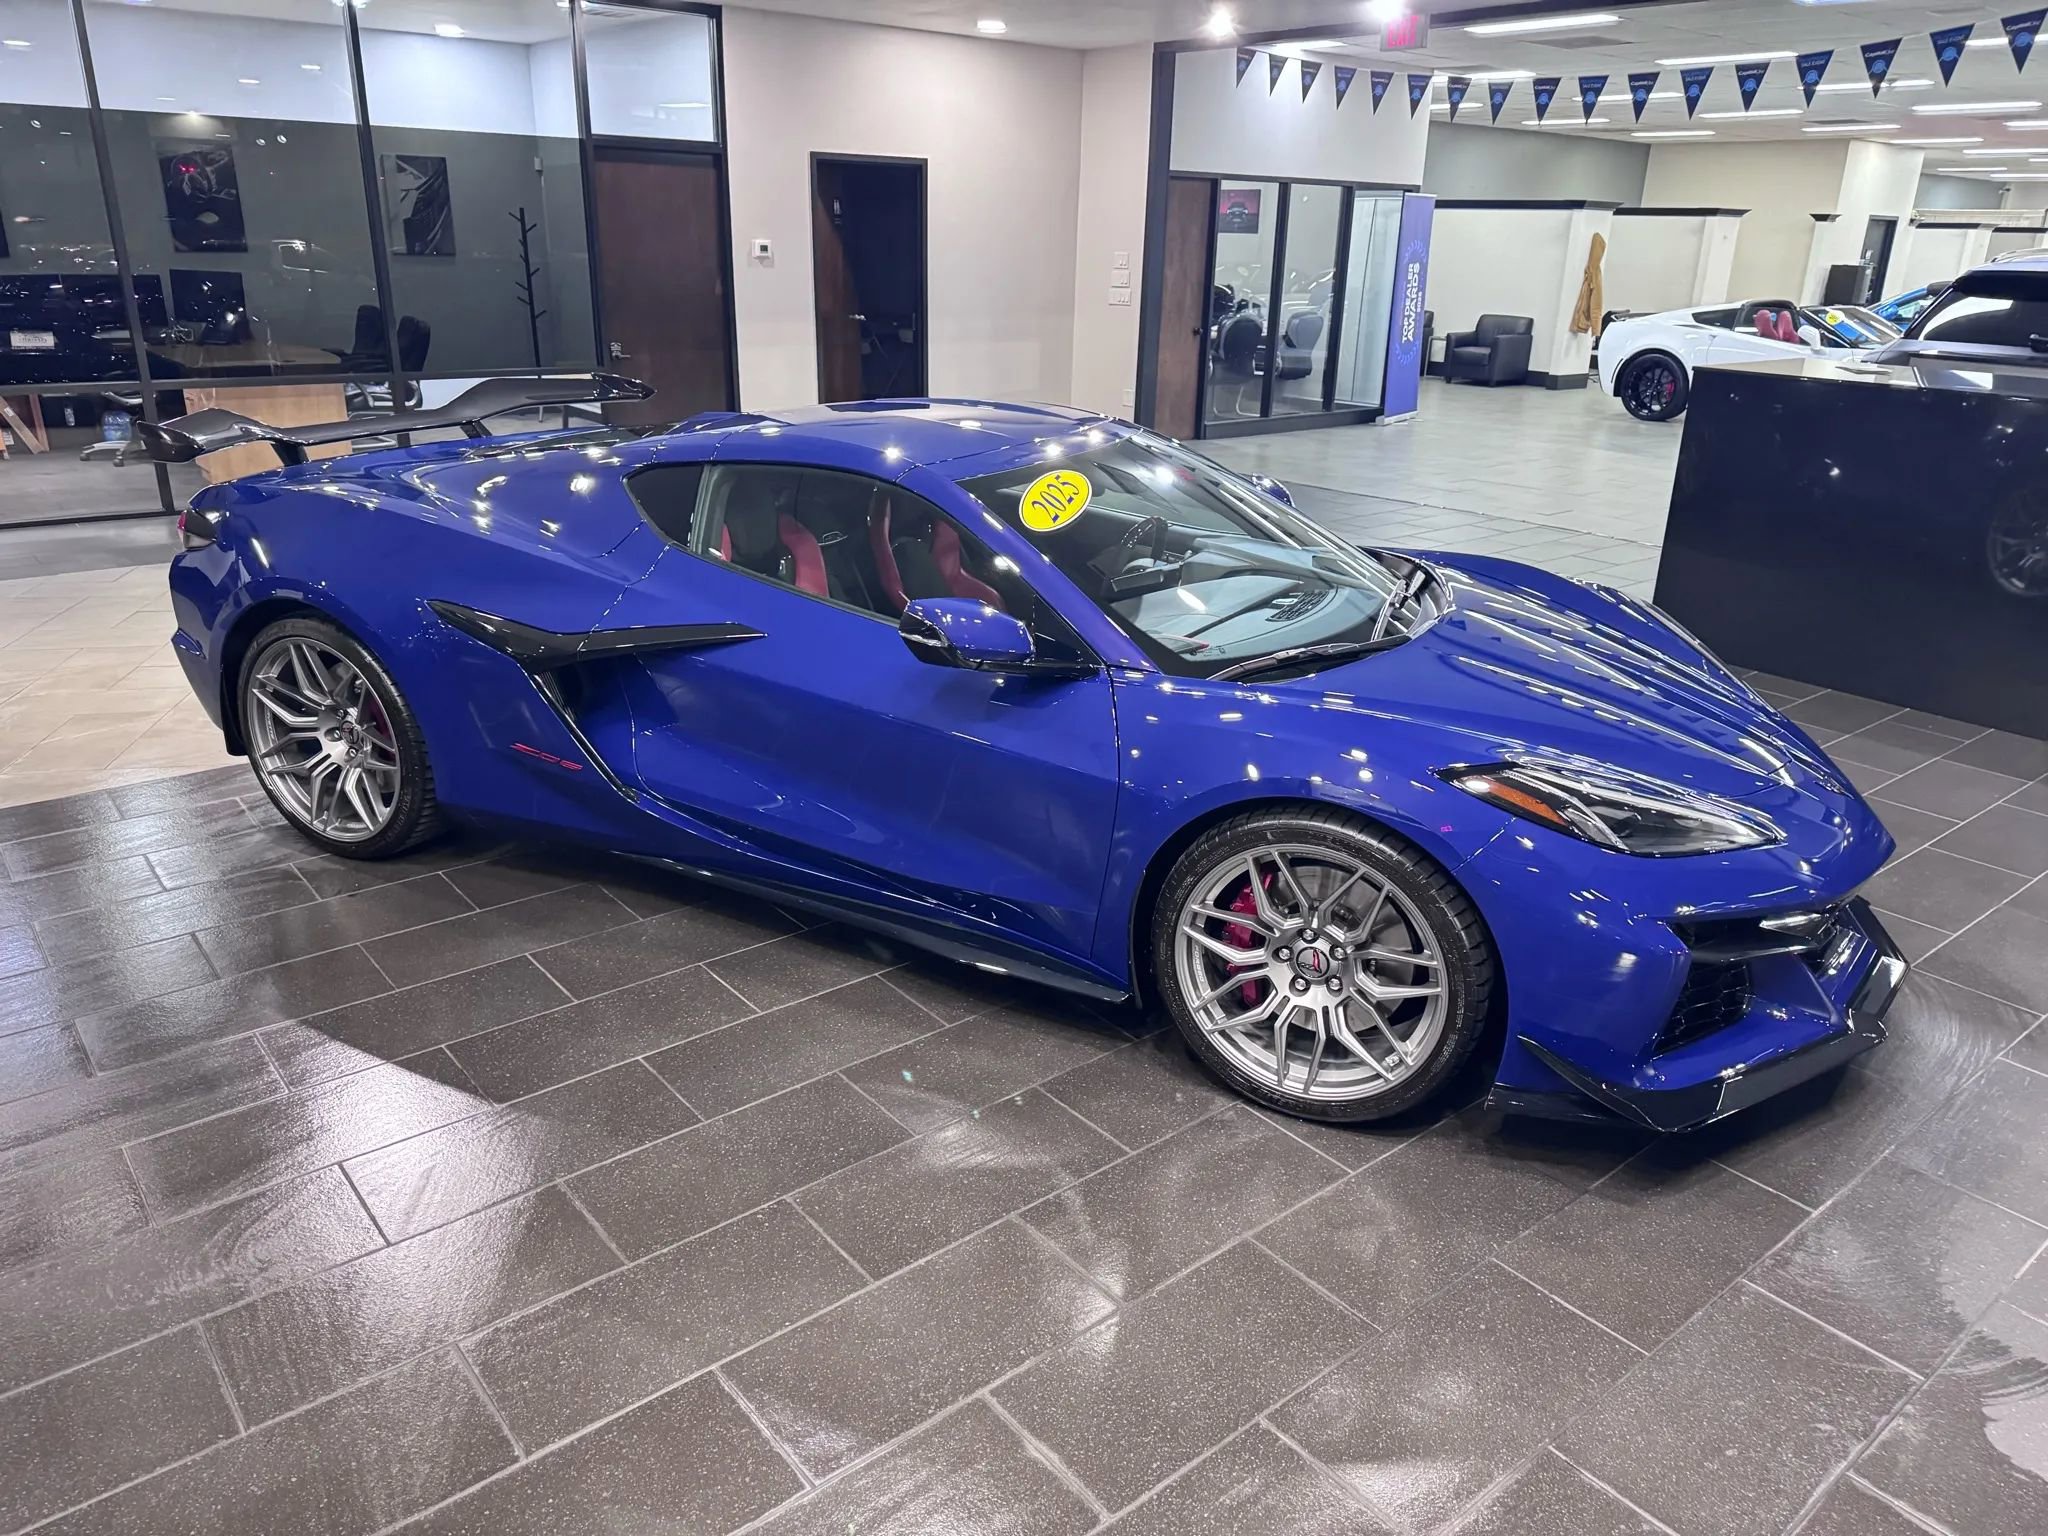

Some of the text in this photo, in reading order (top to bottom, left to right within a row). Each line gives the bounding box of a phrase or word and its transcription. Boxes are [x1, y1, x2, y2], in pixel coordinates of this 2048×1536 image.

[1405, 264, 1414, 316] DEALER
[1408, 262, 1420, 342] AWARDS
[1031, 474, 1079, 524] 2025
